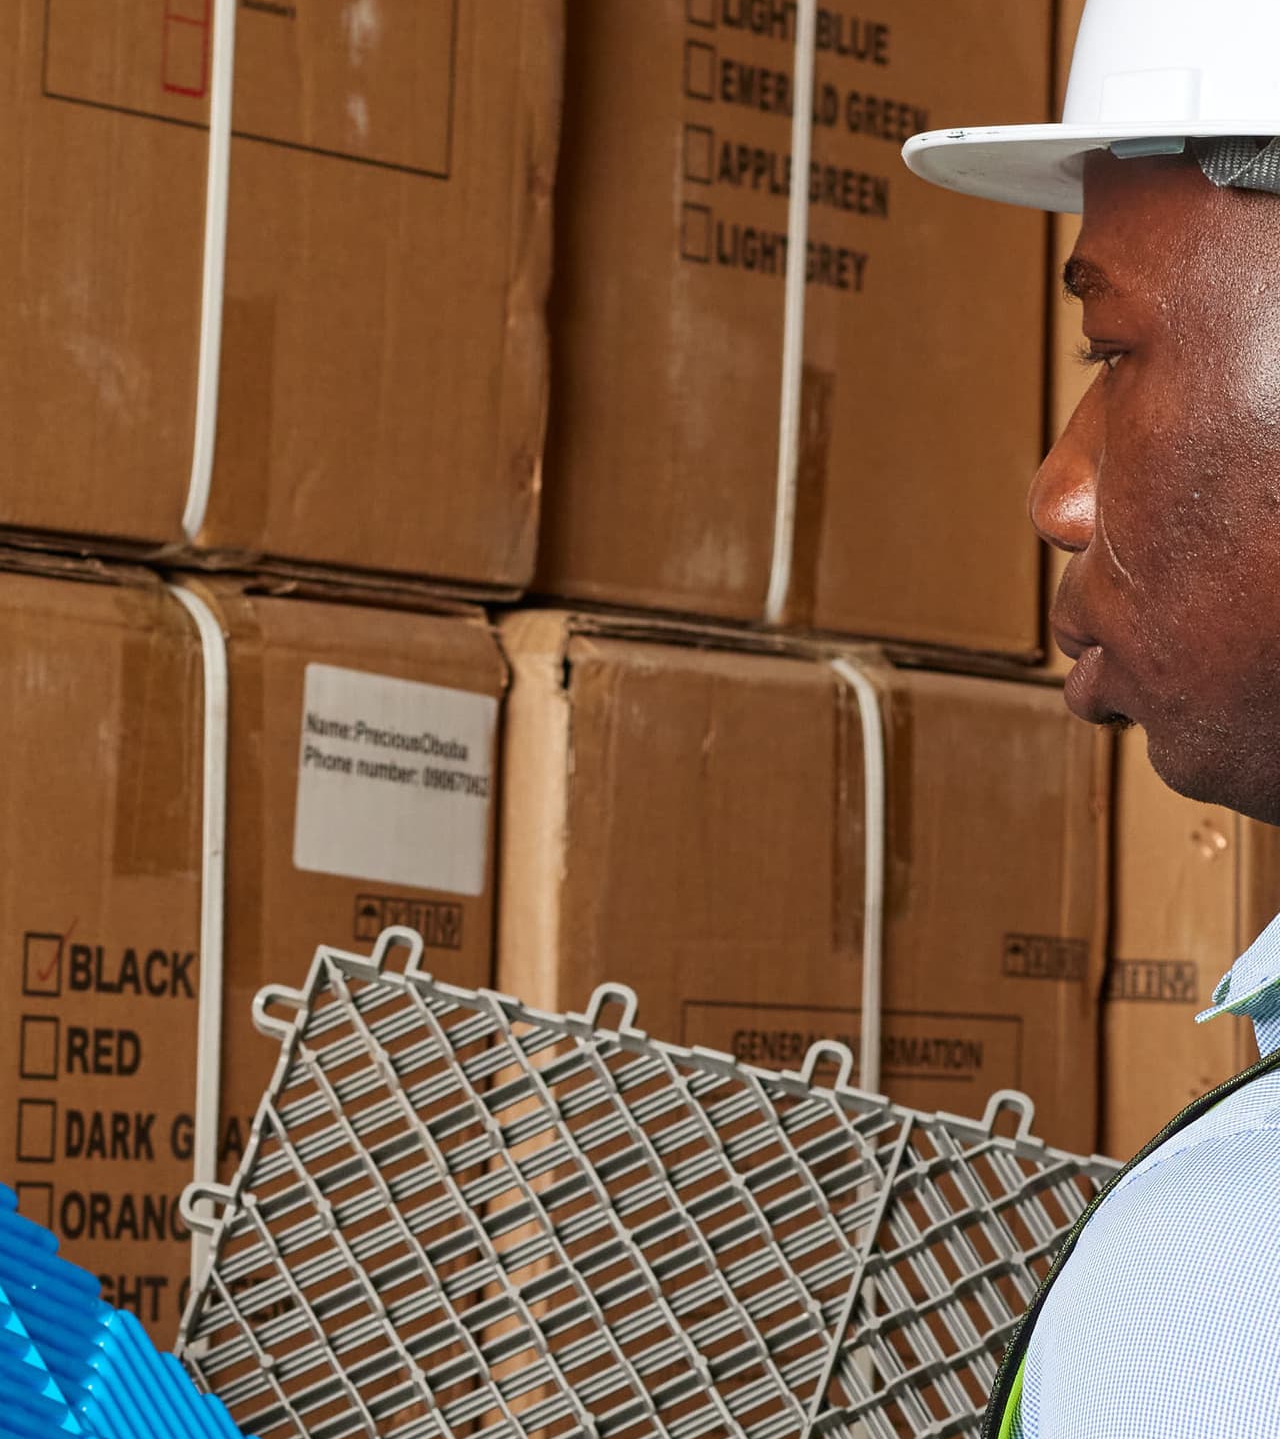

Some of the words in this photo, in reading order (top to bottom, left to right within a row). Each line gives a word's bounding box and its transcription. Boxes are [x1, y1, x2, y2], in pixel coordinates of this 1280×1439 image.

[720, 59, 838, 128] EMERD
[845, 88, 928, 141] GREEN
[716, 147, 792, 197] APPL
[305, 744, 352, 774] Phone
[68, 944, 195, 999] BLACK
[65, 1028, 141, 1077] RED
[65, 1109, 154, 1160] DARK
[98, 1275, 168, 1321] GHT
